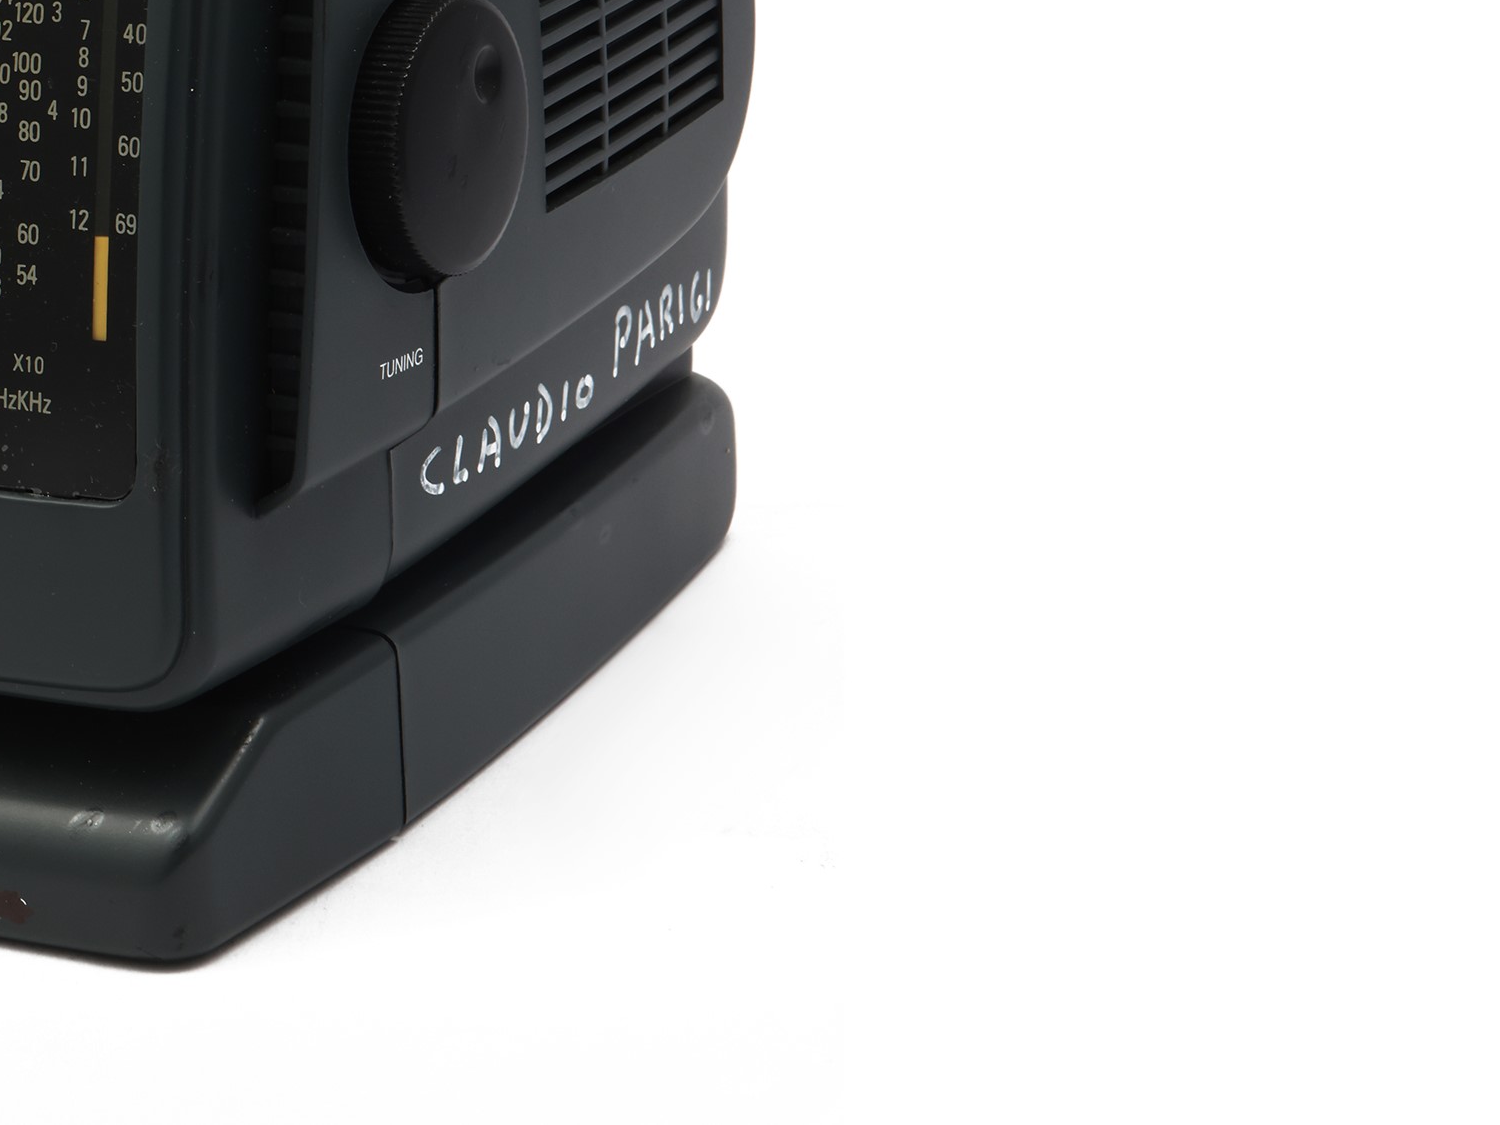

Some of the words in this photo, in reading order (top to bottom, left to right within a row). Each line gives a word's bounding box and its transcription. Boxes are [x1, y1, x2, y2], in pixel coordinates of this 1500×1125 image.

[14, 1, 45, 25] 120
[51, 1, 62, 23] 3
[80, 19, 91, 41] 7
[123, 23, 147, 45] 40
[12, 51, 42, 75] 100
[78, 46, 89, 68] 8
[19, 79, 42, 102] 90
[77, 75, 88, 97] 9
[121, 71, 144, 93] 50
[47, 99, 58, 121] 4
[71, 107, 91, 130] 10
[18, 120, 40, 143] 80
[118, 135, 141, 158] 60
[20, 159, 41, 182] 70
[70, 155, 88, 177] 11
[69, 208, 89, 232] 12
[115, 212, 137, 235] 69
[17, 222, 39, 245] 60
[16, 264, 38, 286] 54
[12, 353, 44, 375] X10
[379, 347, 424, 380] TUNING
[420, 373, 595, 496] CLAUDIO
[613, 268, 712, 378] PARIGI
